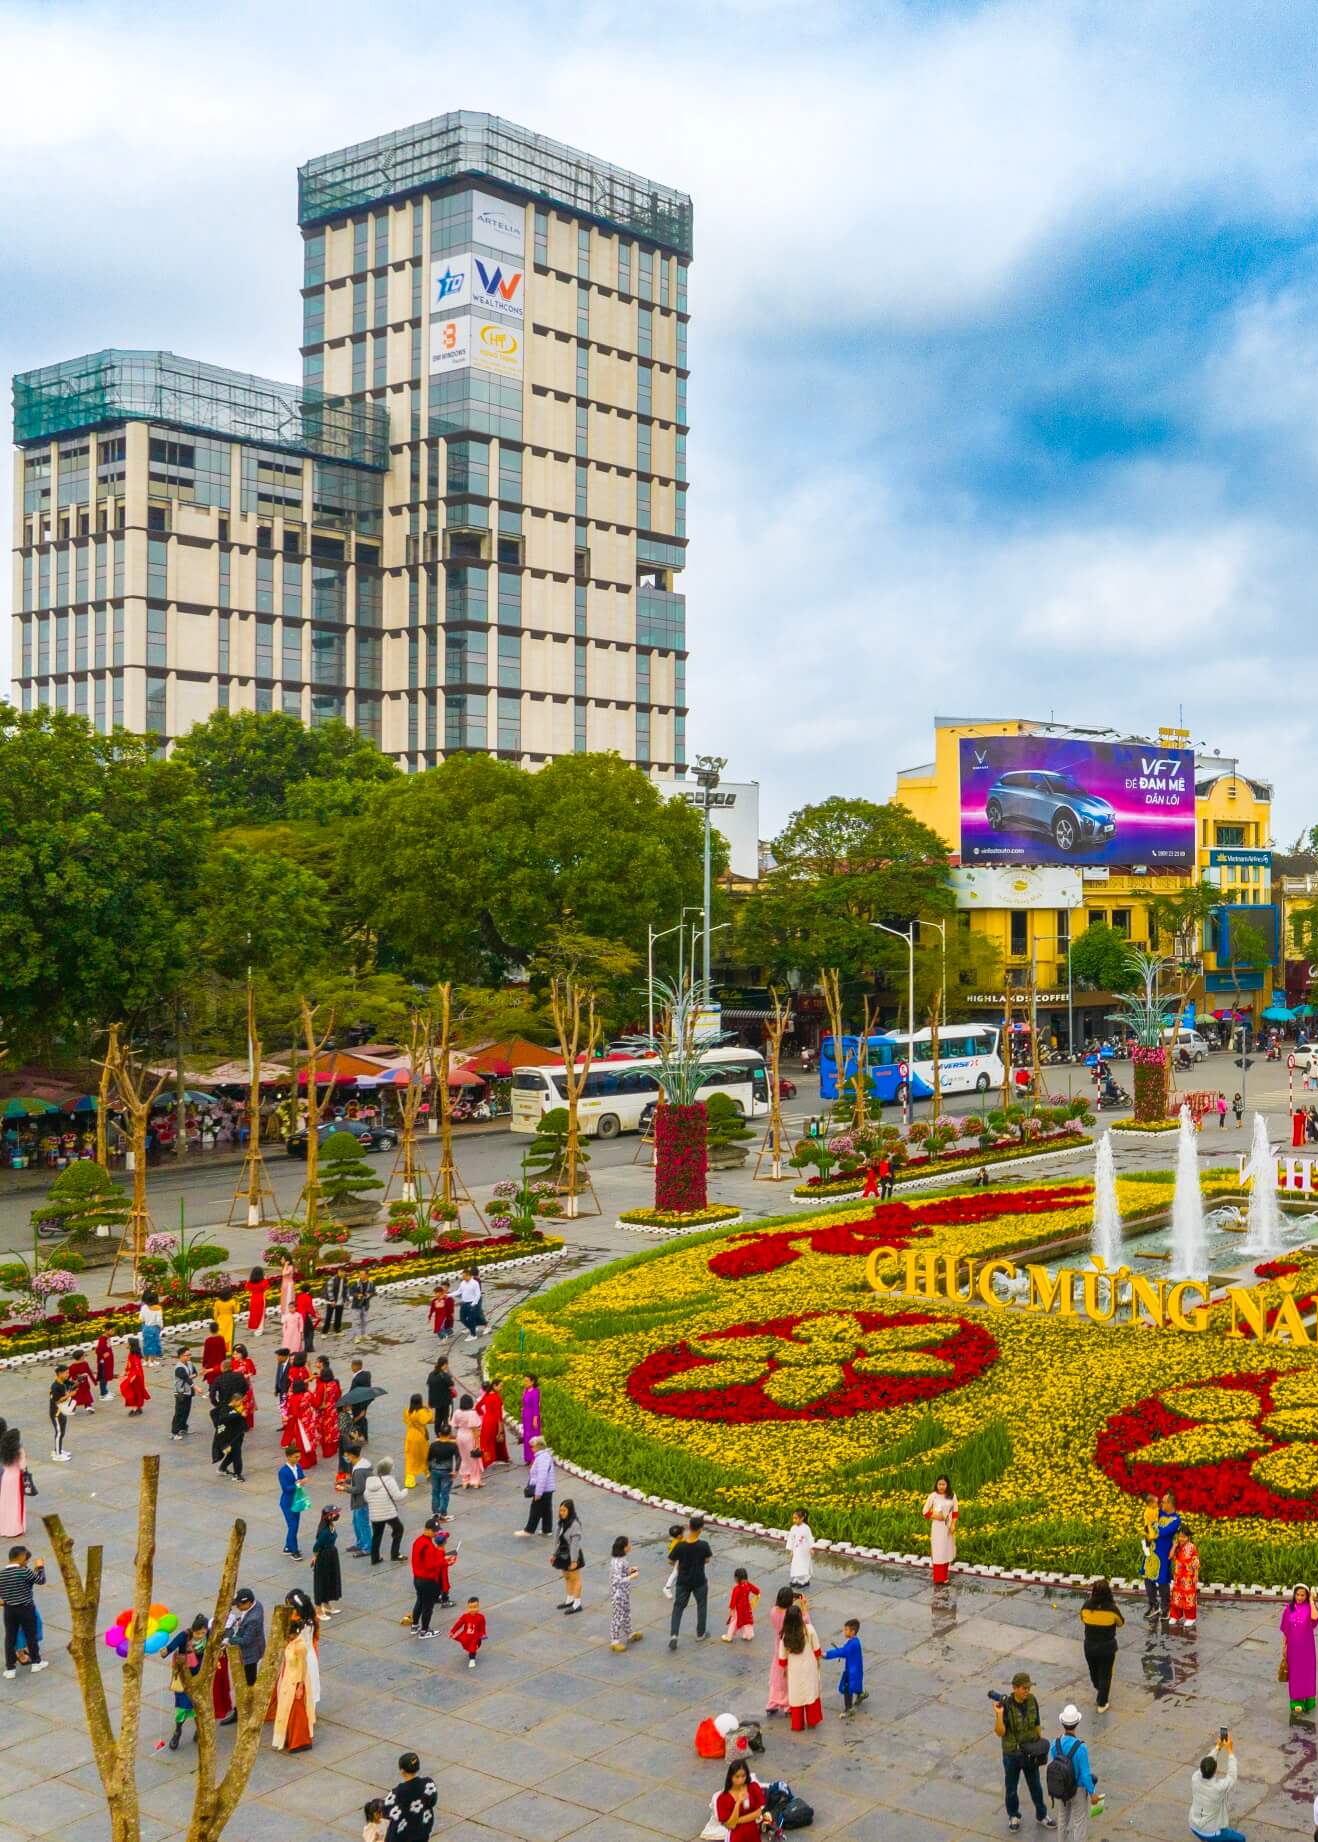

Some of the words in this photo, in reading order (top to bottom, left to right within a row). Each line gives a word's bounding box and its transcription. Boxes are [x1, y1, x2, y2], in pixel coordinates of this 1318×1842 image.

[473, 293, 523, 315] WEALTHCONS
[1141, 757, 1181, 777] VF7
[1139, 777, 1166, 790] ĐAM
[865, 1244, 1017, 1309] CHÚC
[1025, 1254, 1212, 1333] MỪNG
